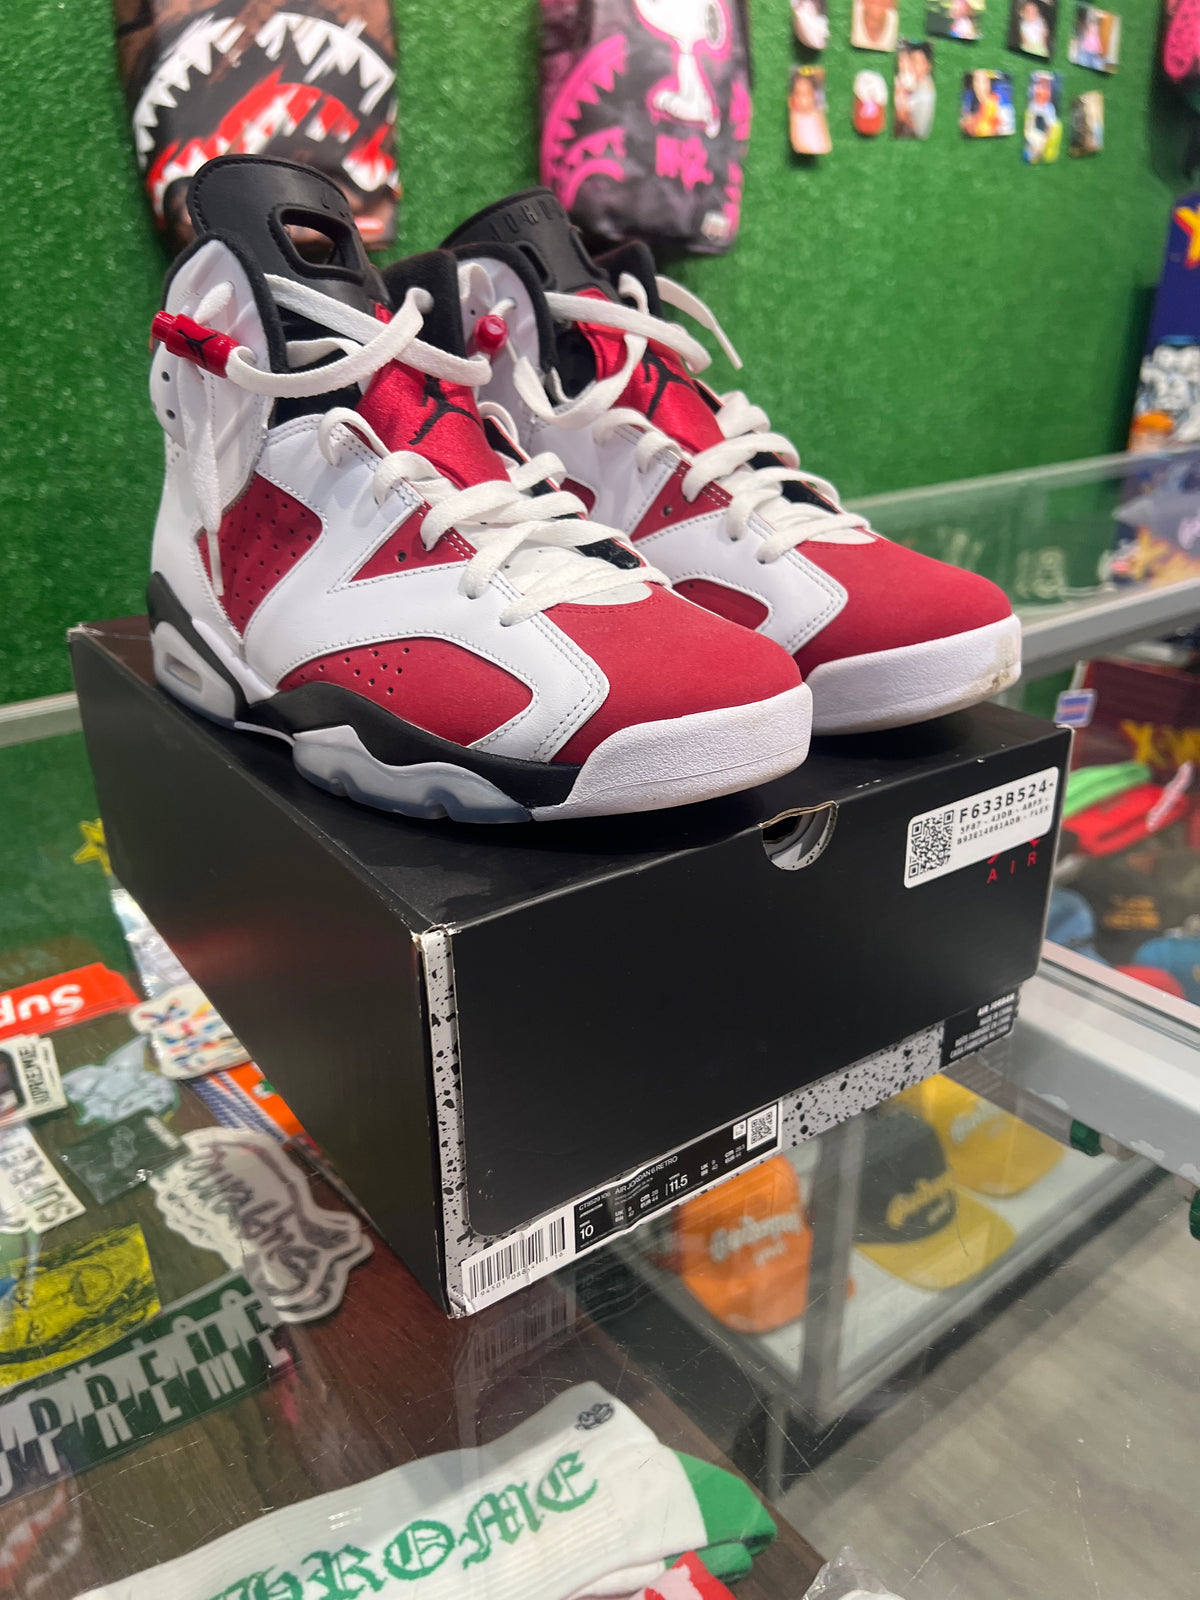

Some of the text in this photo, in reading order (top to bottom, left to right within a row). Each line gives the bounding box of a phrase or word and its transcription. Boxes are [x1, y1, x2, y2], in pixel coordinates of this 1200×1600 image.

[615, 1185, 627, 1195] AIR
[626, 1169, 651, 1187] JORDAN
[655, 1155, 679, 1173] RETRO
[669, 1174, 688, 1193] 11.5
[580, 1224, 595, 1240] 10
